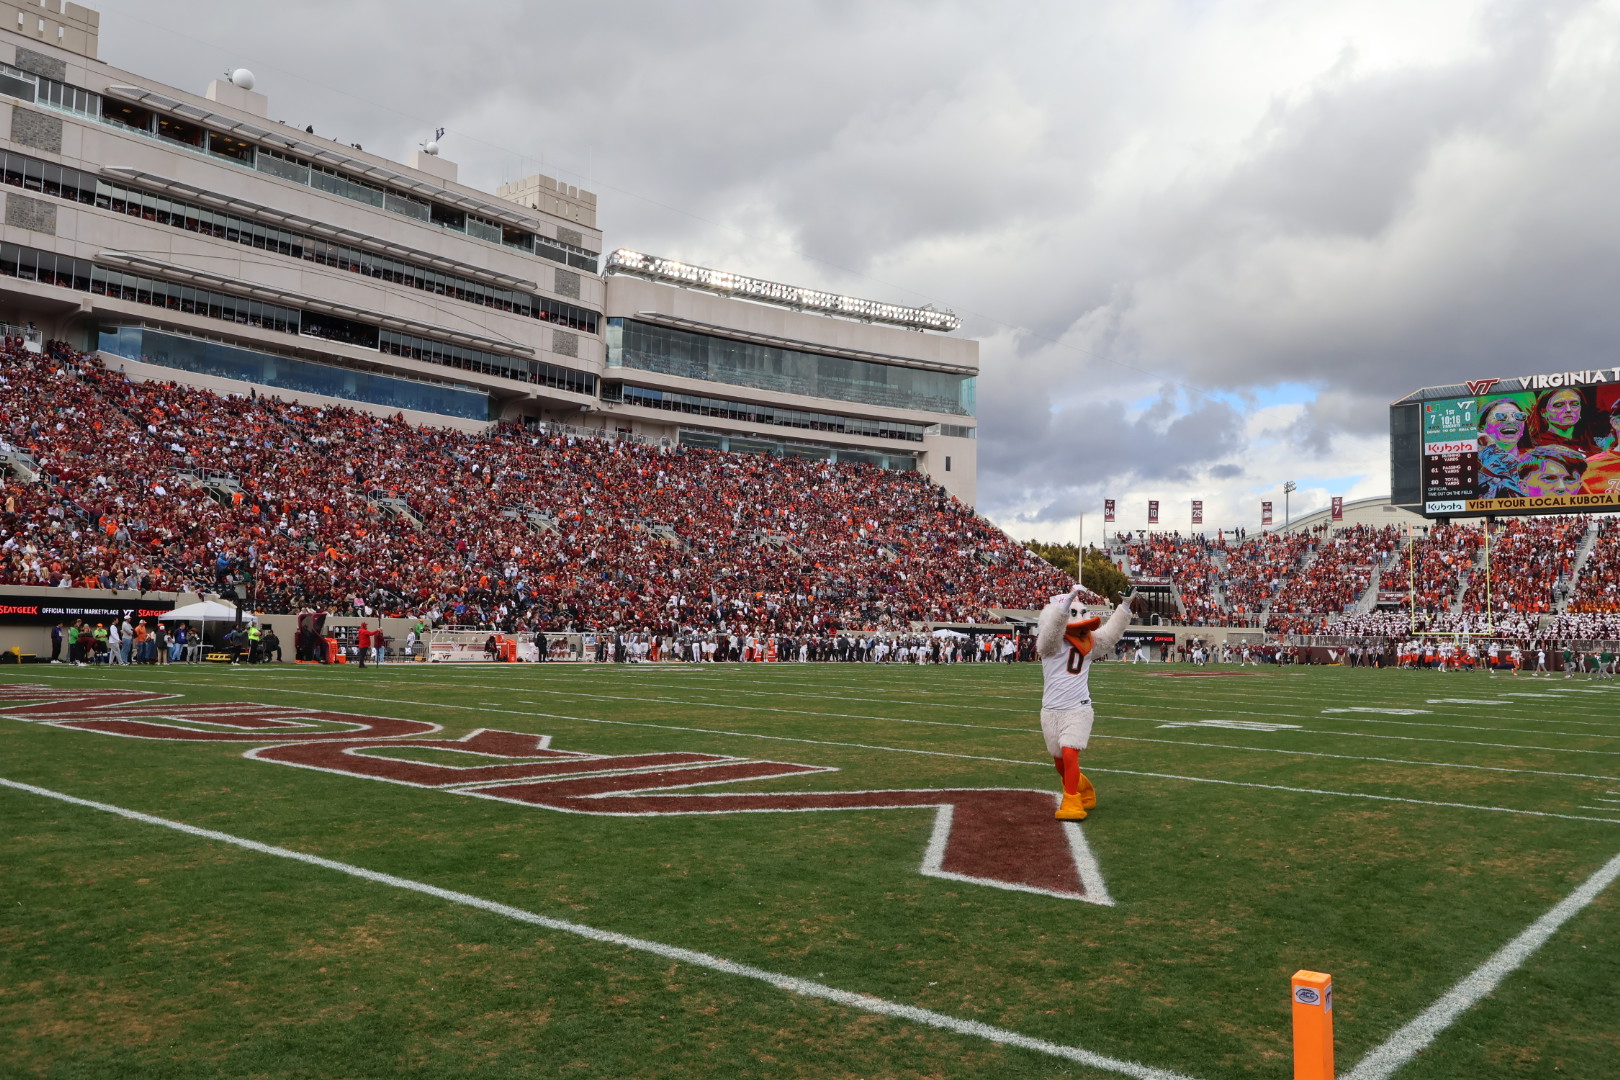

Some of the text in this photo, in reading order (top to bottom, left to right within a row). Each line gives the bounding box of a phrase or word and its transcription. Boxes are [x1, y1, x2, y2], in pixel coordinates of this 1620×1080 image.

[1518, 369, 1607, 390] VIRGINIA
[1466, 377, 1500, 395] VT
[1457, 400, 1475, 409] VT
[1430, 415, 1436, 424] 7
[1465, 411, 1471, 421] 0
[1428, 442, 1473, 453] Kubota
[1469, 500, 1494, 509] VISIT
[1498, 499, 1525, 508] YOUR
[1529, 497, 1566, 507] LOCAL
[1570, 495, 1614, 505] KUBOTA
[1334, 505, 1340, 514] 7
[1428, 503, 1462, 511] Kubota
[1105, 508, 1115, 516] 84
[1150, 509, 1157, 517] 10
[1193, 509, 1202, 517] 25
[0, 605, 38, 615] SEATGEEK
[138, 609, 174, 617] SEATGE
[1300, 991, 1315, 999] ACC
